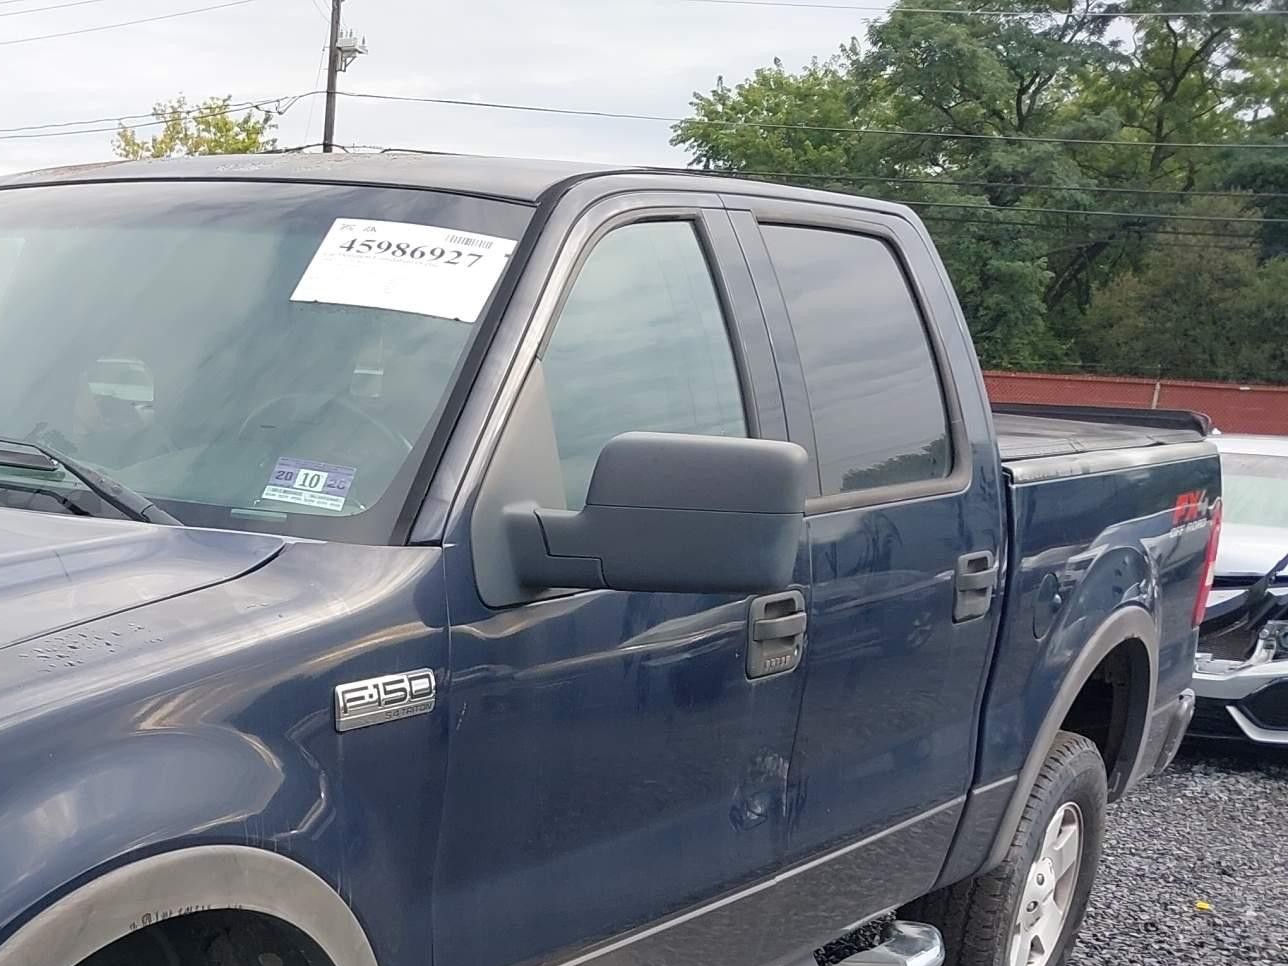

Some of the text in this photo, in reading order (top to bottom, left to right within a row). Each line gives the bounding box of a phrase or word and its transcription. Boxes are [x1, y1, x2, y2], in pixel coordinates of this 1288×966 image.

[338, 237, 484, 268] 45986927
[275, 470, 294, 481] 20
[299, 472, 321, 488] 10
[1174, 490, 1209, 524] FX4
